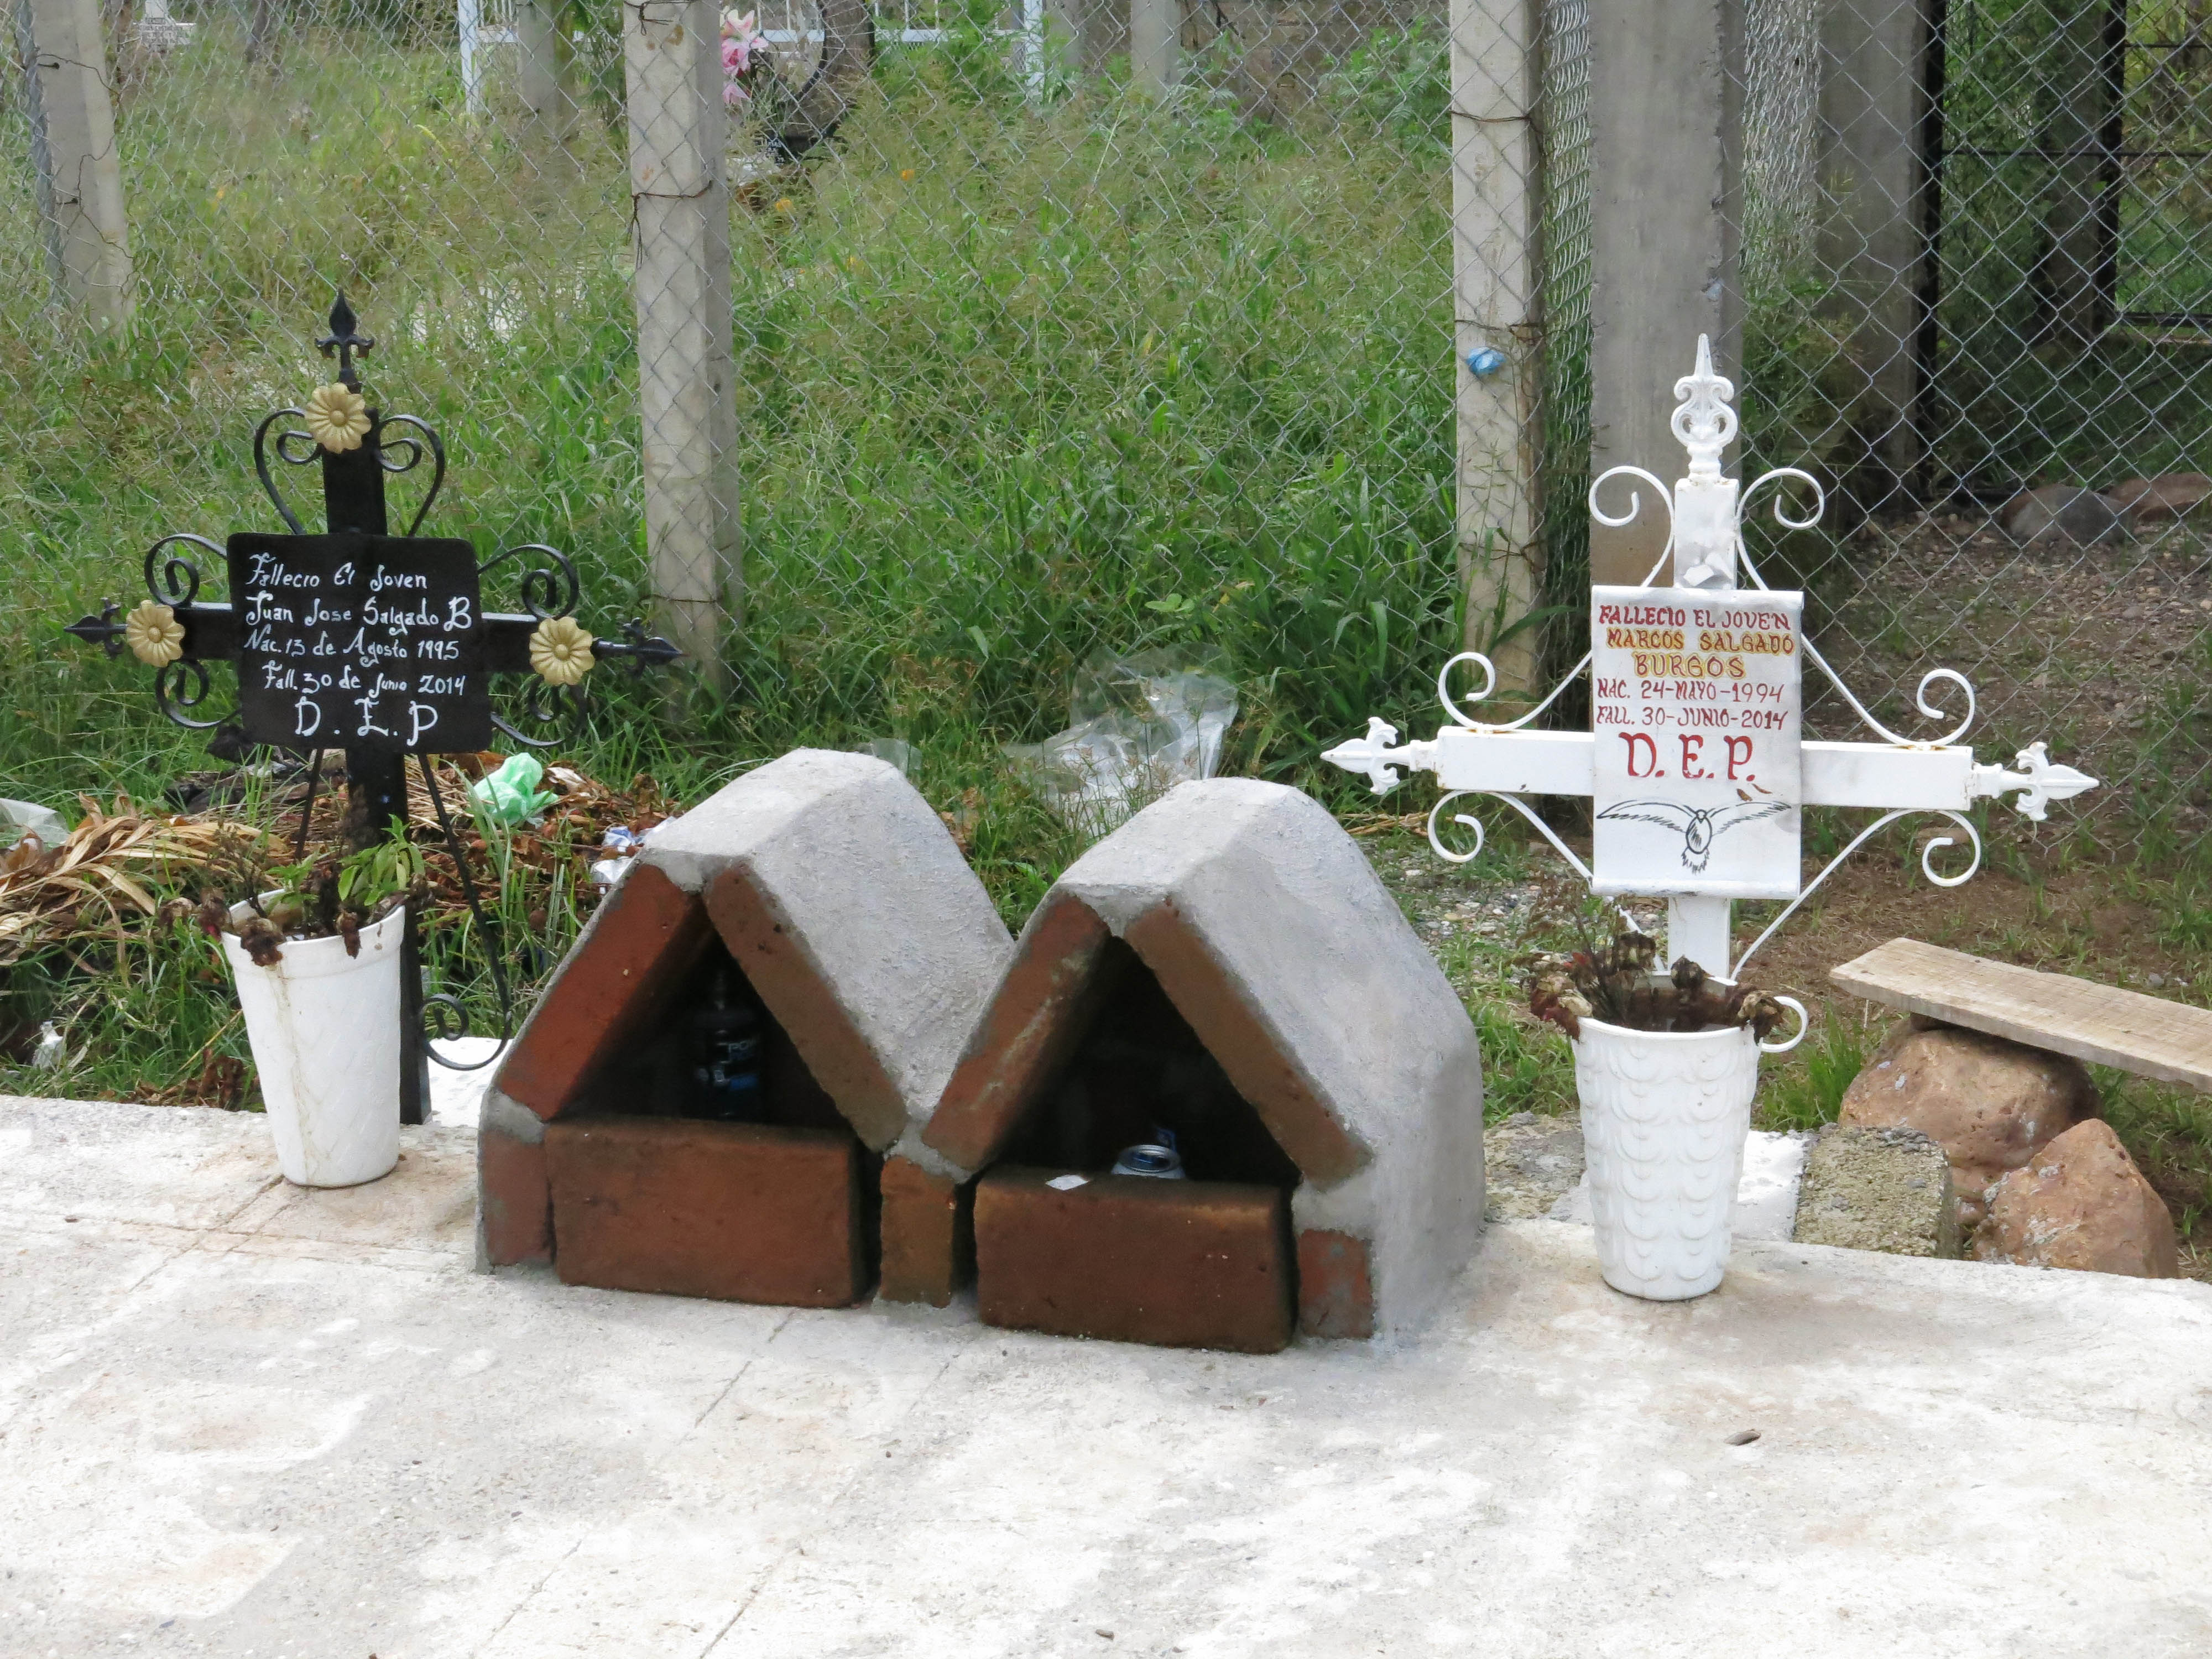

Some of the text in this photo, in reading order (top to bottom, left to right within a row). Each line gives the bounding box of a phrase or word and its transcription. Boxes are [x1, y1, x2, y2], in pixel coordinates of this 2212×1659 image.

[371, 564, 426, 591] Joven
[246, 590, 471, 635] Juan Jose Salgado B
[1599, 605, 1791, 630] FALLECIO EL JOVEN
[244, 624, 459, 667] Nac. 13 de Agosto 1995
[1606, 628, 1795, 655] MARCOS SALGADO
[262, 660, 465, 698] Fall. 30 de Junio 2014
[1632, 653, 1745, 678] BURGOS
[1598, 679, 1630, 699] NAC.
[1597, 706, 1634, 724] FALL.
